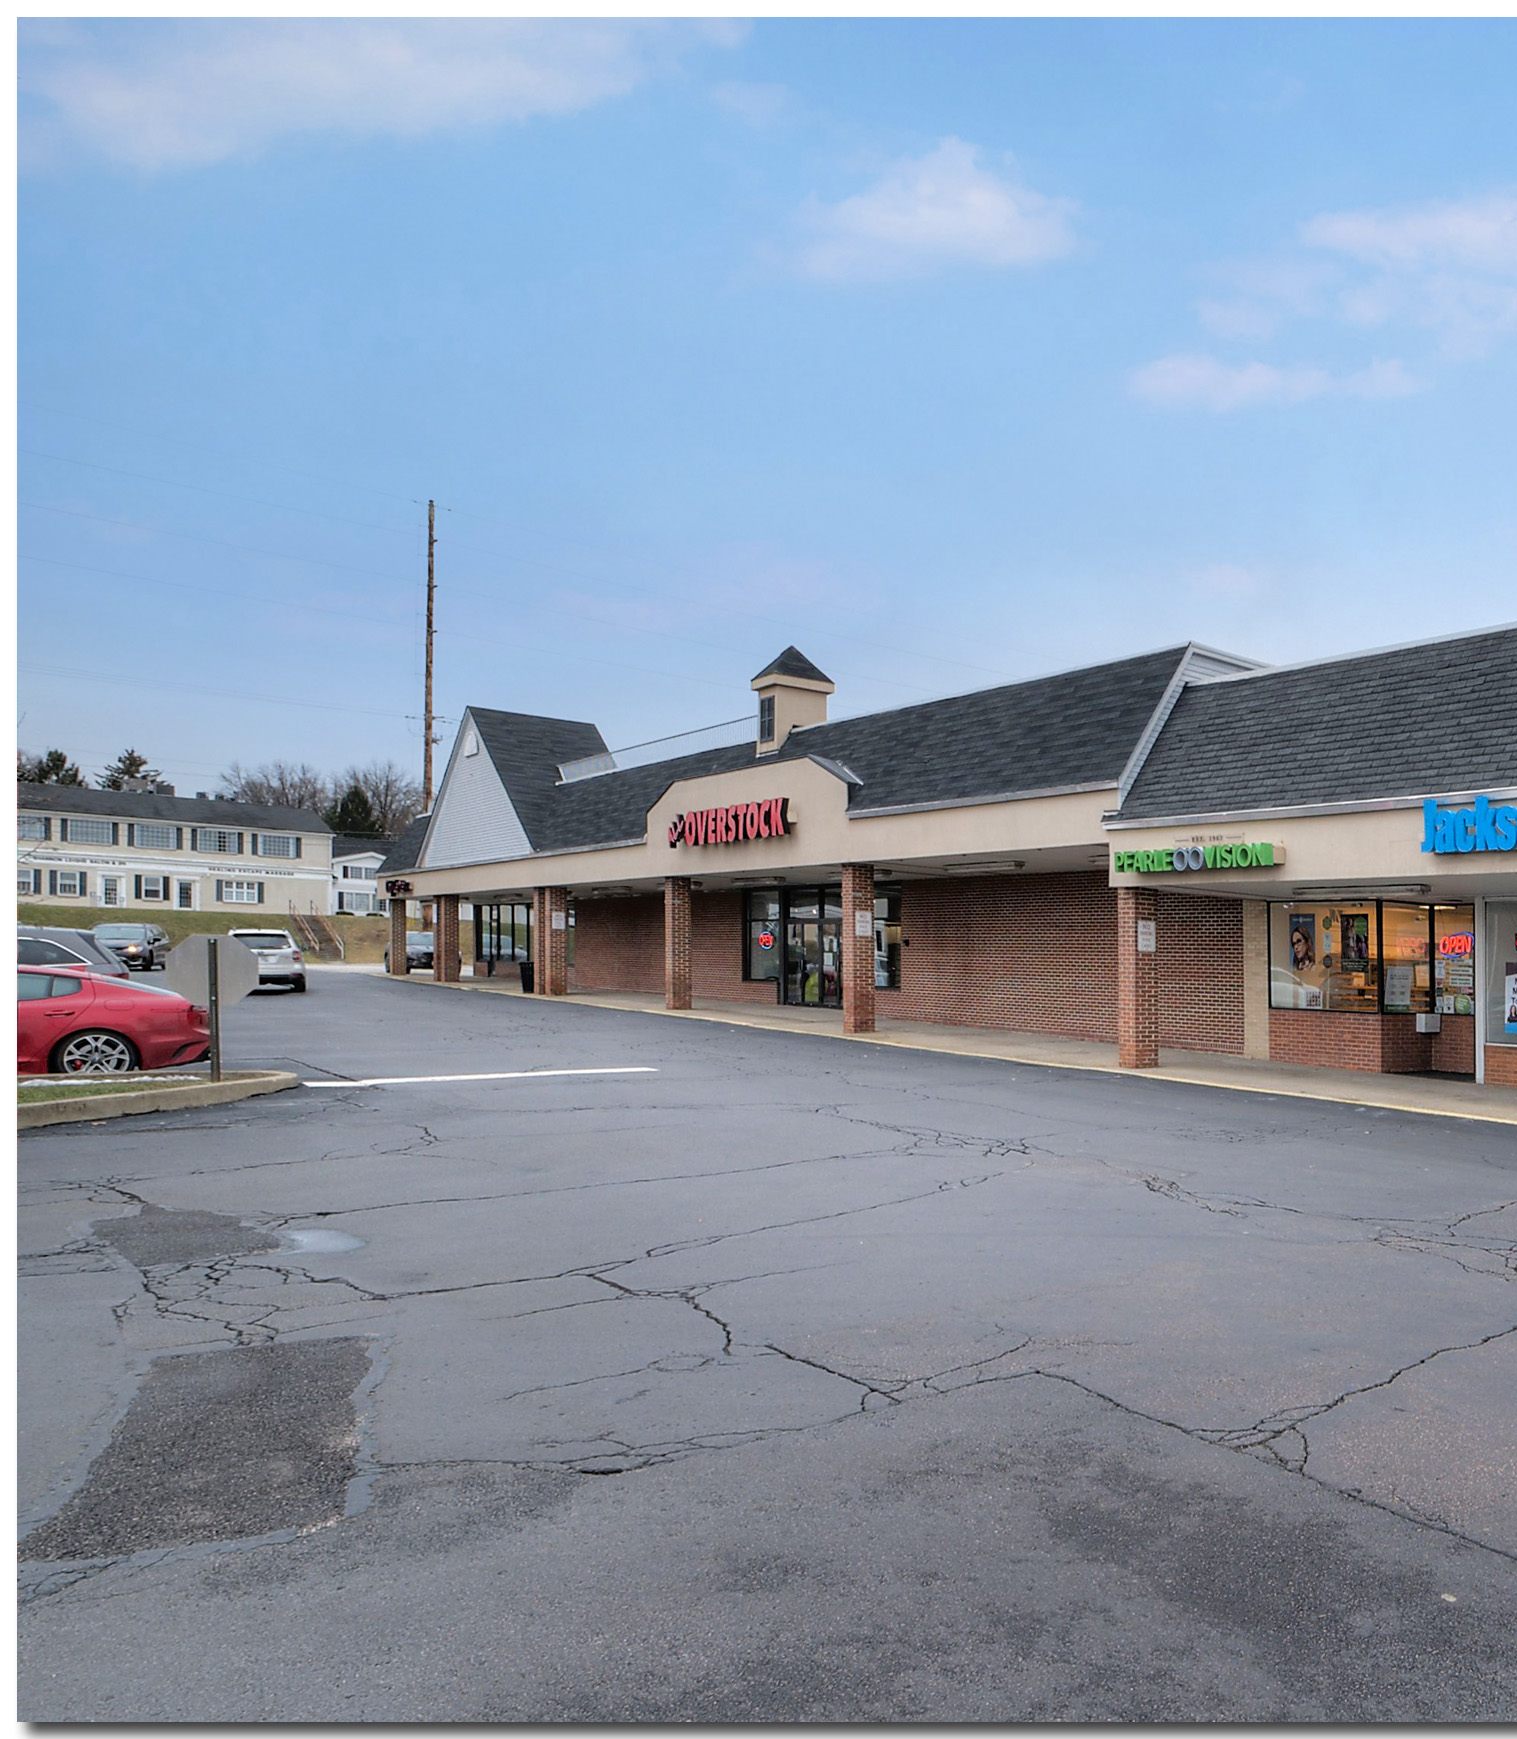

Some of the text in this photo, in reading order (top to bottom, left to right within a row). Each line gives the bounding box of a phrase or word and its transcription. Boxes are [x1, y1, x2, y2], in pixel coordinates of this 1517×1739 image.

[684, 797, 788, 846] OVERSTOCK
[1114, 843, 1272, 873] PEARLE VISION
[1439, 934, 1472, 954] OPEN
